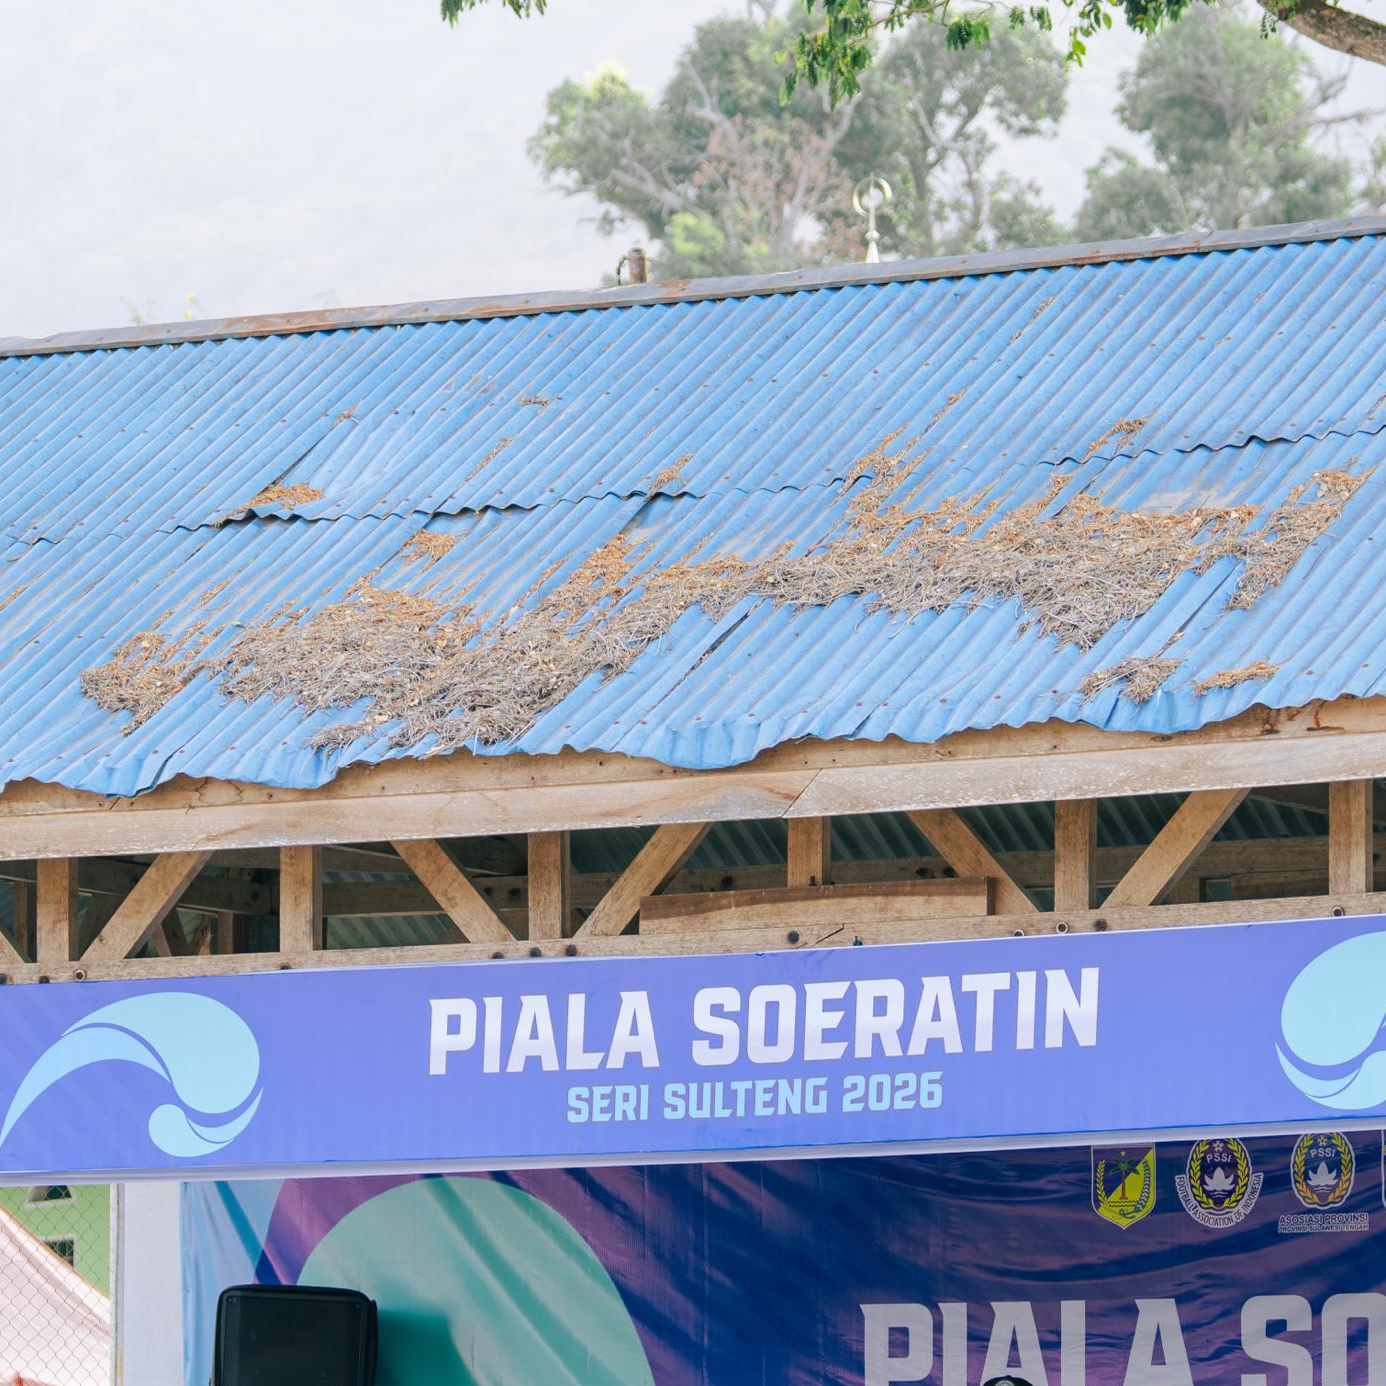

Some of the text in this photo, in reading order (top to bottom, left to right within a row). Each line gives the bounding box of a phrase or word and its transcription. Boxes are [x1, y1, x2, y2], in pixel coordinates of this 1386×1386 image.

[429, 967, 1100, 1076] PIALA SOERATIN
[566, 1071, 944, 1124] SERI SULTENG 2026
[1206, 1152, 1231, 1164] PSSI
[1310, 1148, 1336, 1158] PSSI
[1176, 1174, 1262, 1227] FOOTBALL ASSOCIATION OF INDONESIA
[1280, 1213, 1369, 1225] ASOSIASI PROVINSI
